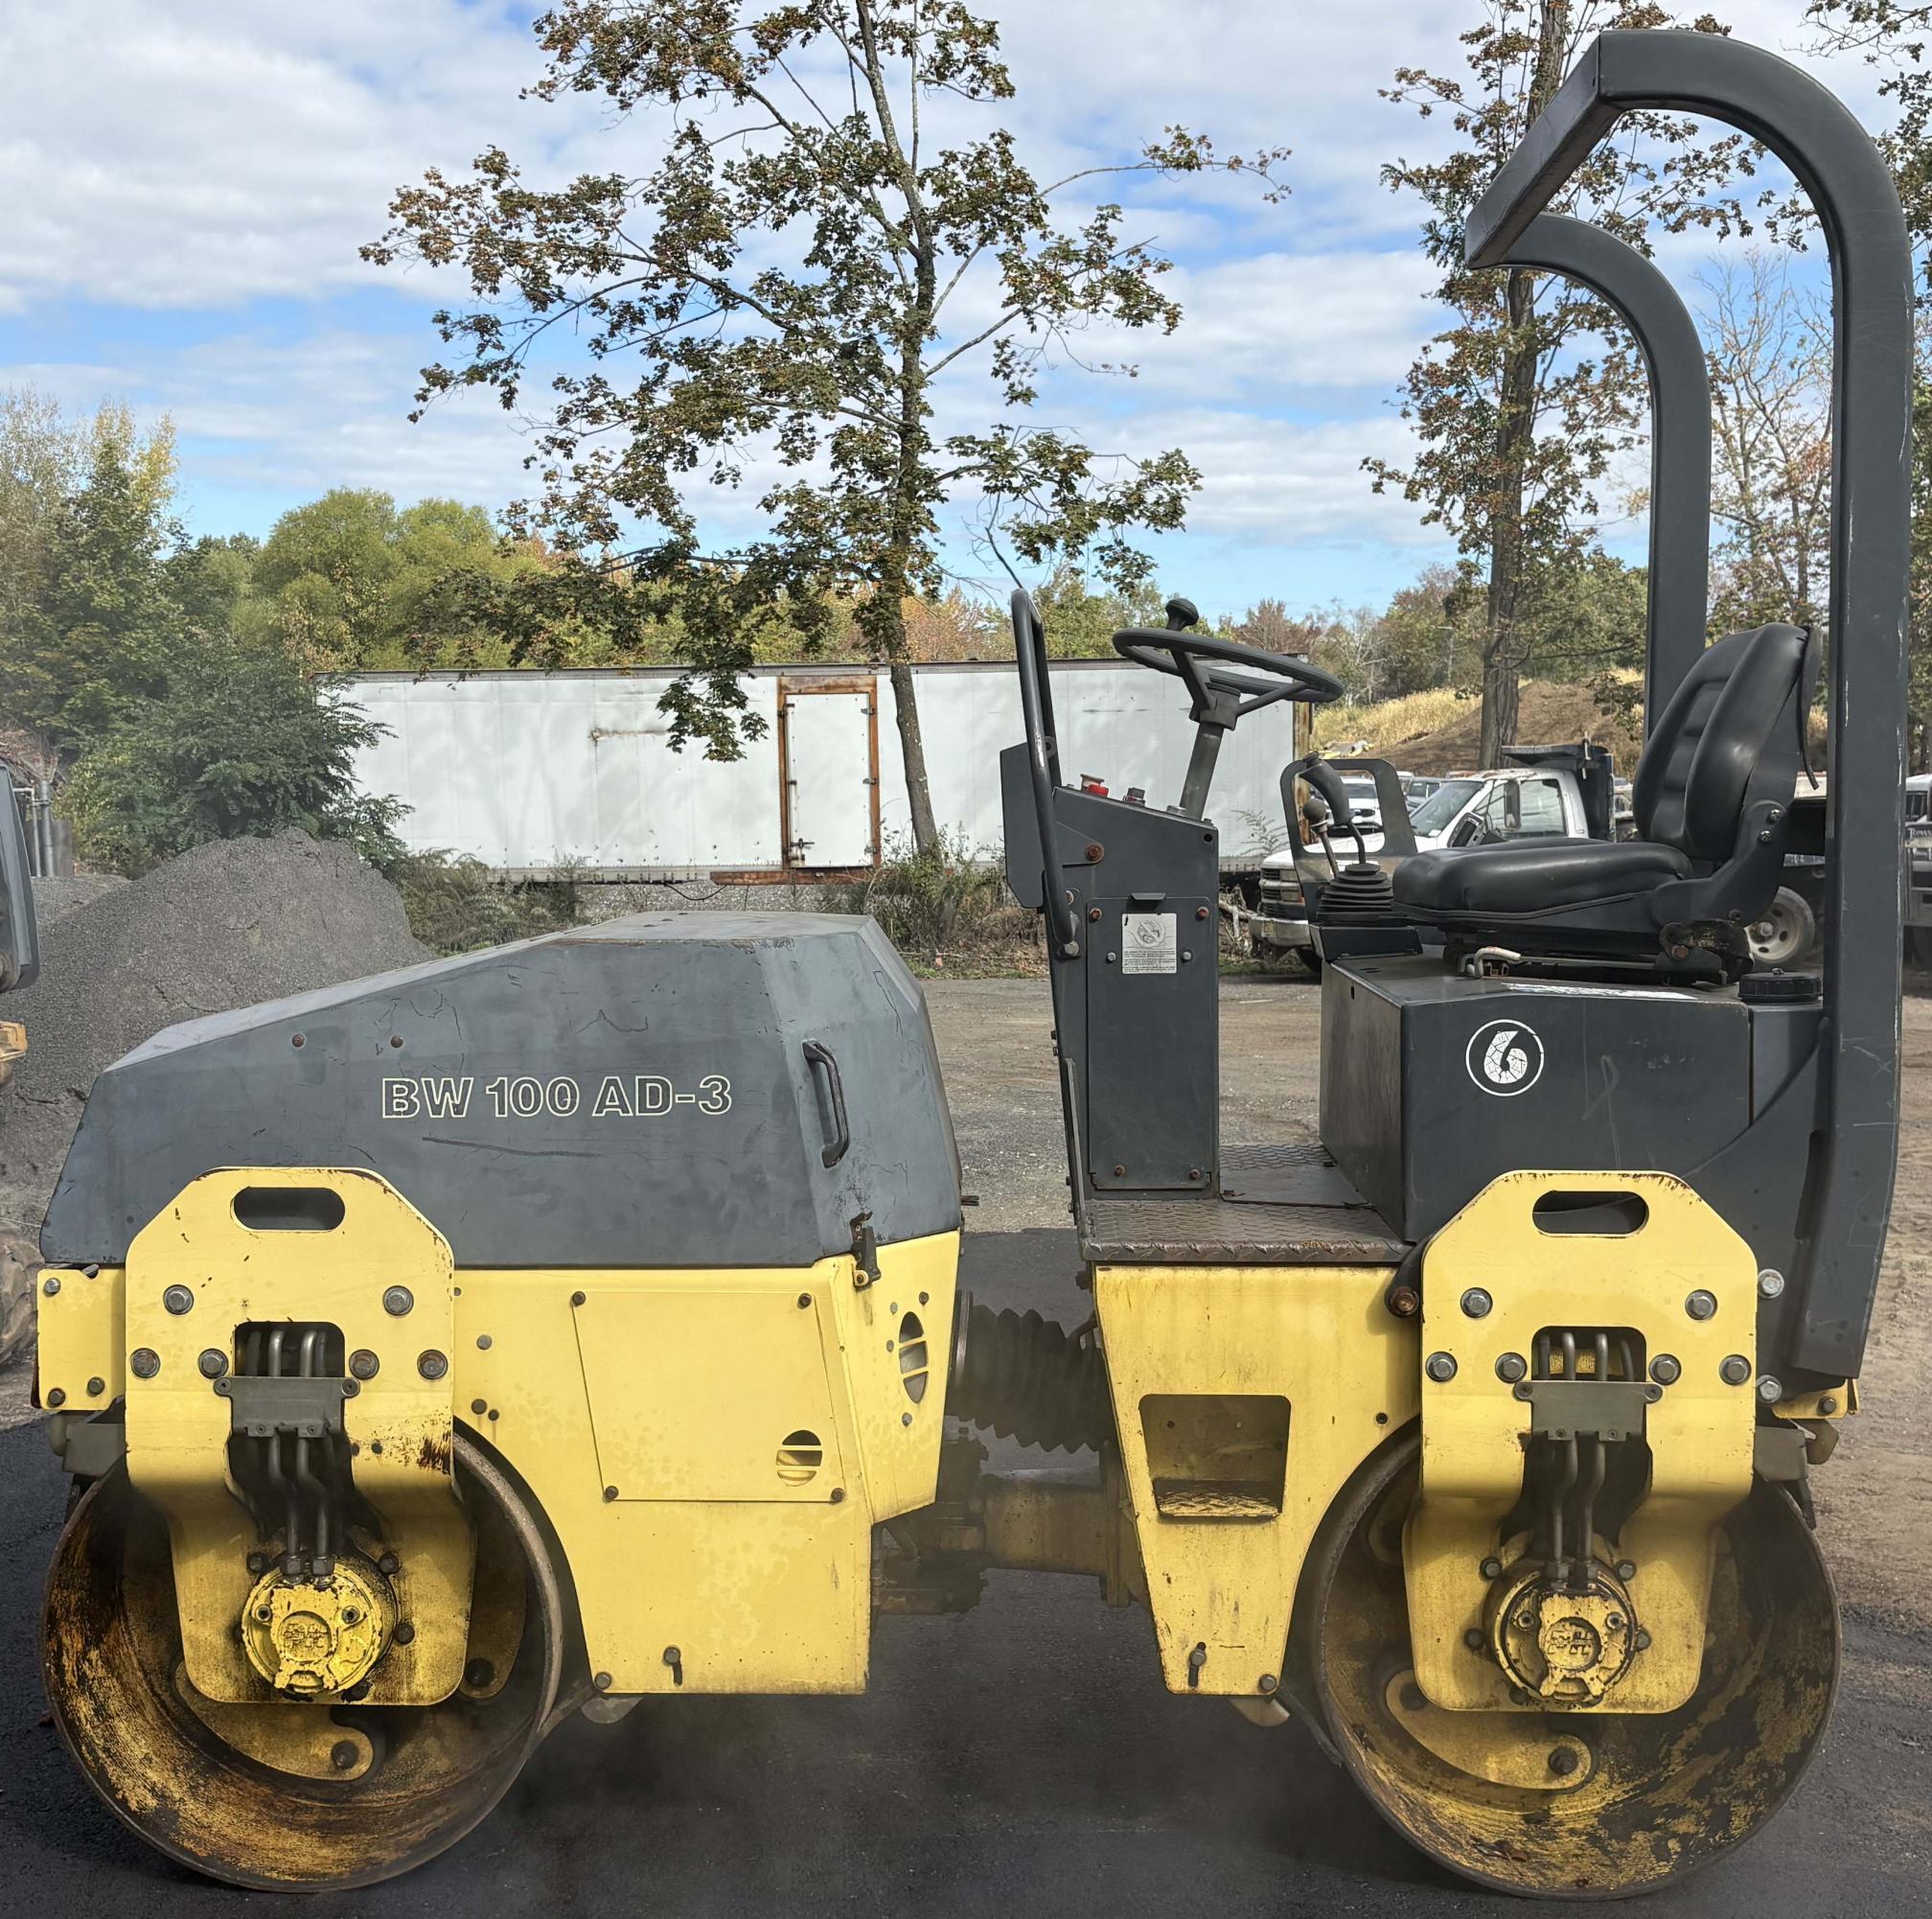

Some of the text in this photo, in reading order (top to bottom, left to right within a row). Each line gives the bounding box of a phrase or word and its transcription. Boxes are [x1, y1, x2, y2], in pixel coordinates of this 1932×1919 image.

[1484, 1030, 1528, 1083] 6
[381, 1075, 732, 1119] BW 100 AD-3
